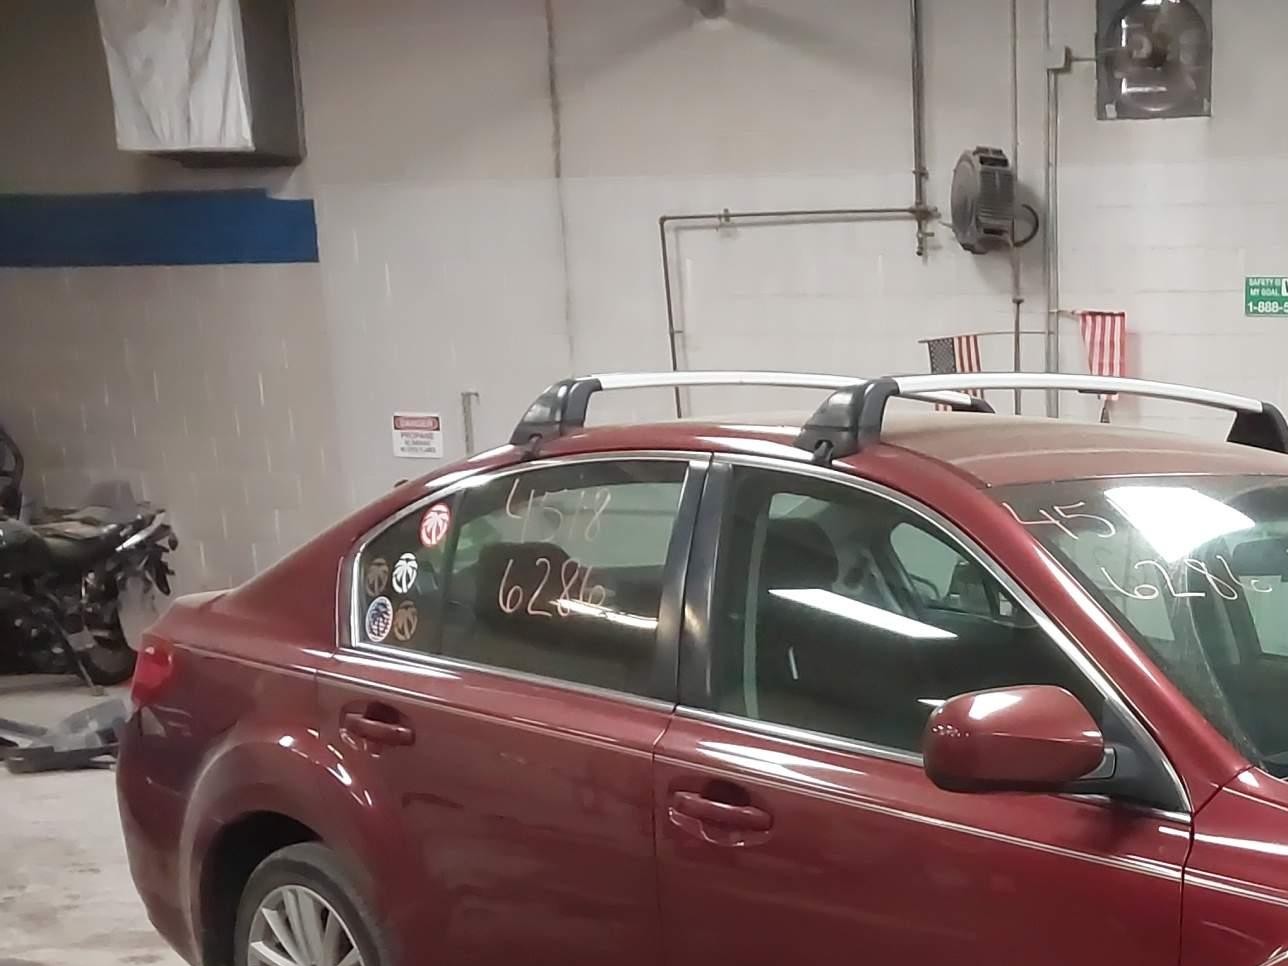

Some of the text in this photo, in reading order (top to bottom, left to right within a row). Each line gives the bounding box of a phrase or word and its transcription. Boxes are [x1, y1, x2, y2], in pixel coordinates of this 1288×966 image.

[1249, 278, 1275, 286] SAFETY
[1250, 288, 1279, 296] MY GOAL
[505, 478, 612, 543] 4518
[498, 557, 607, 617] 6286
